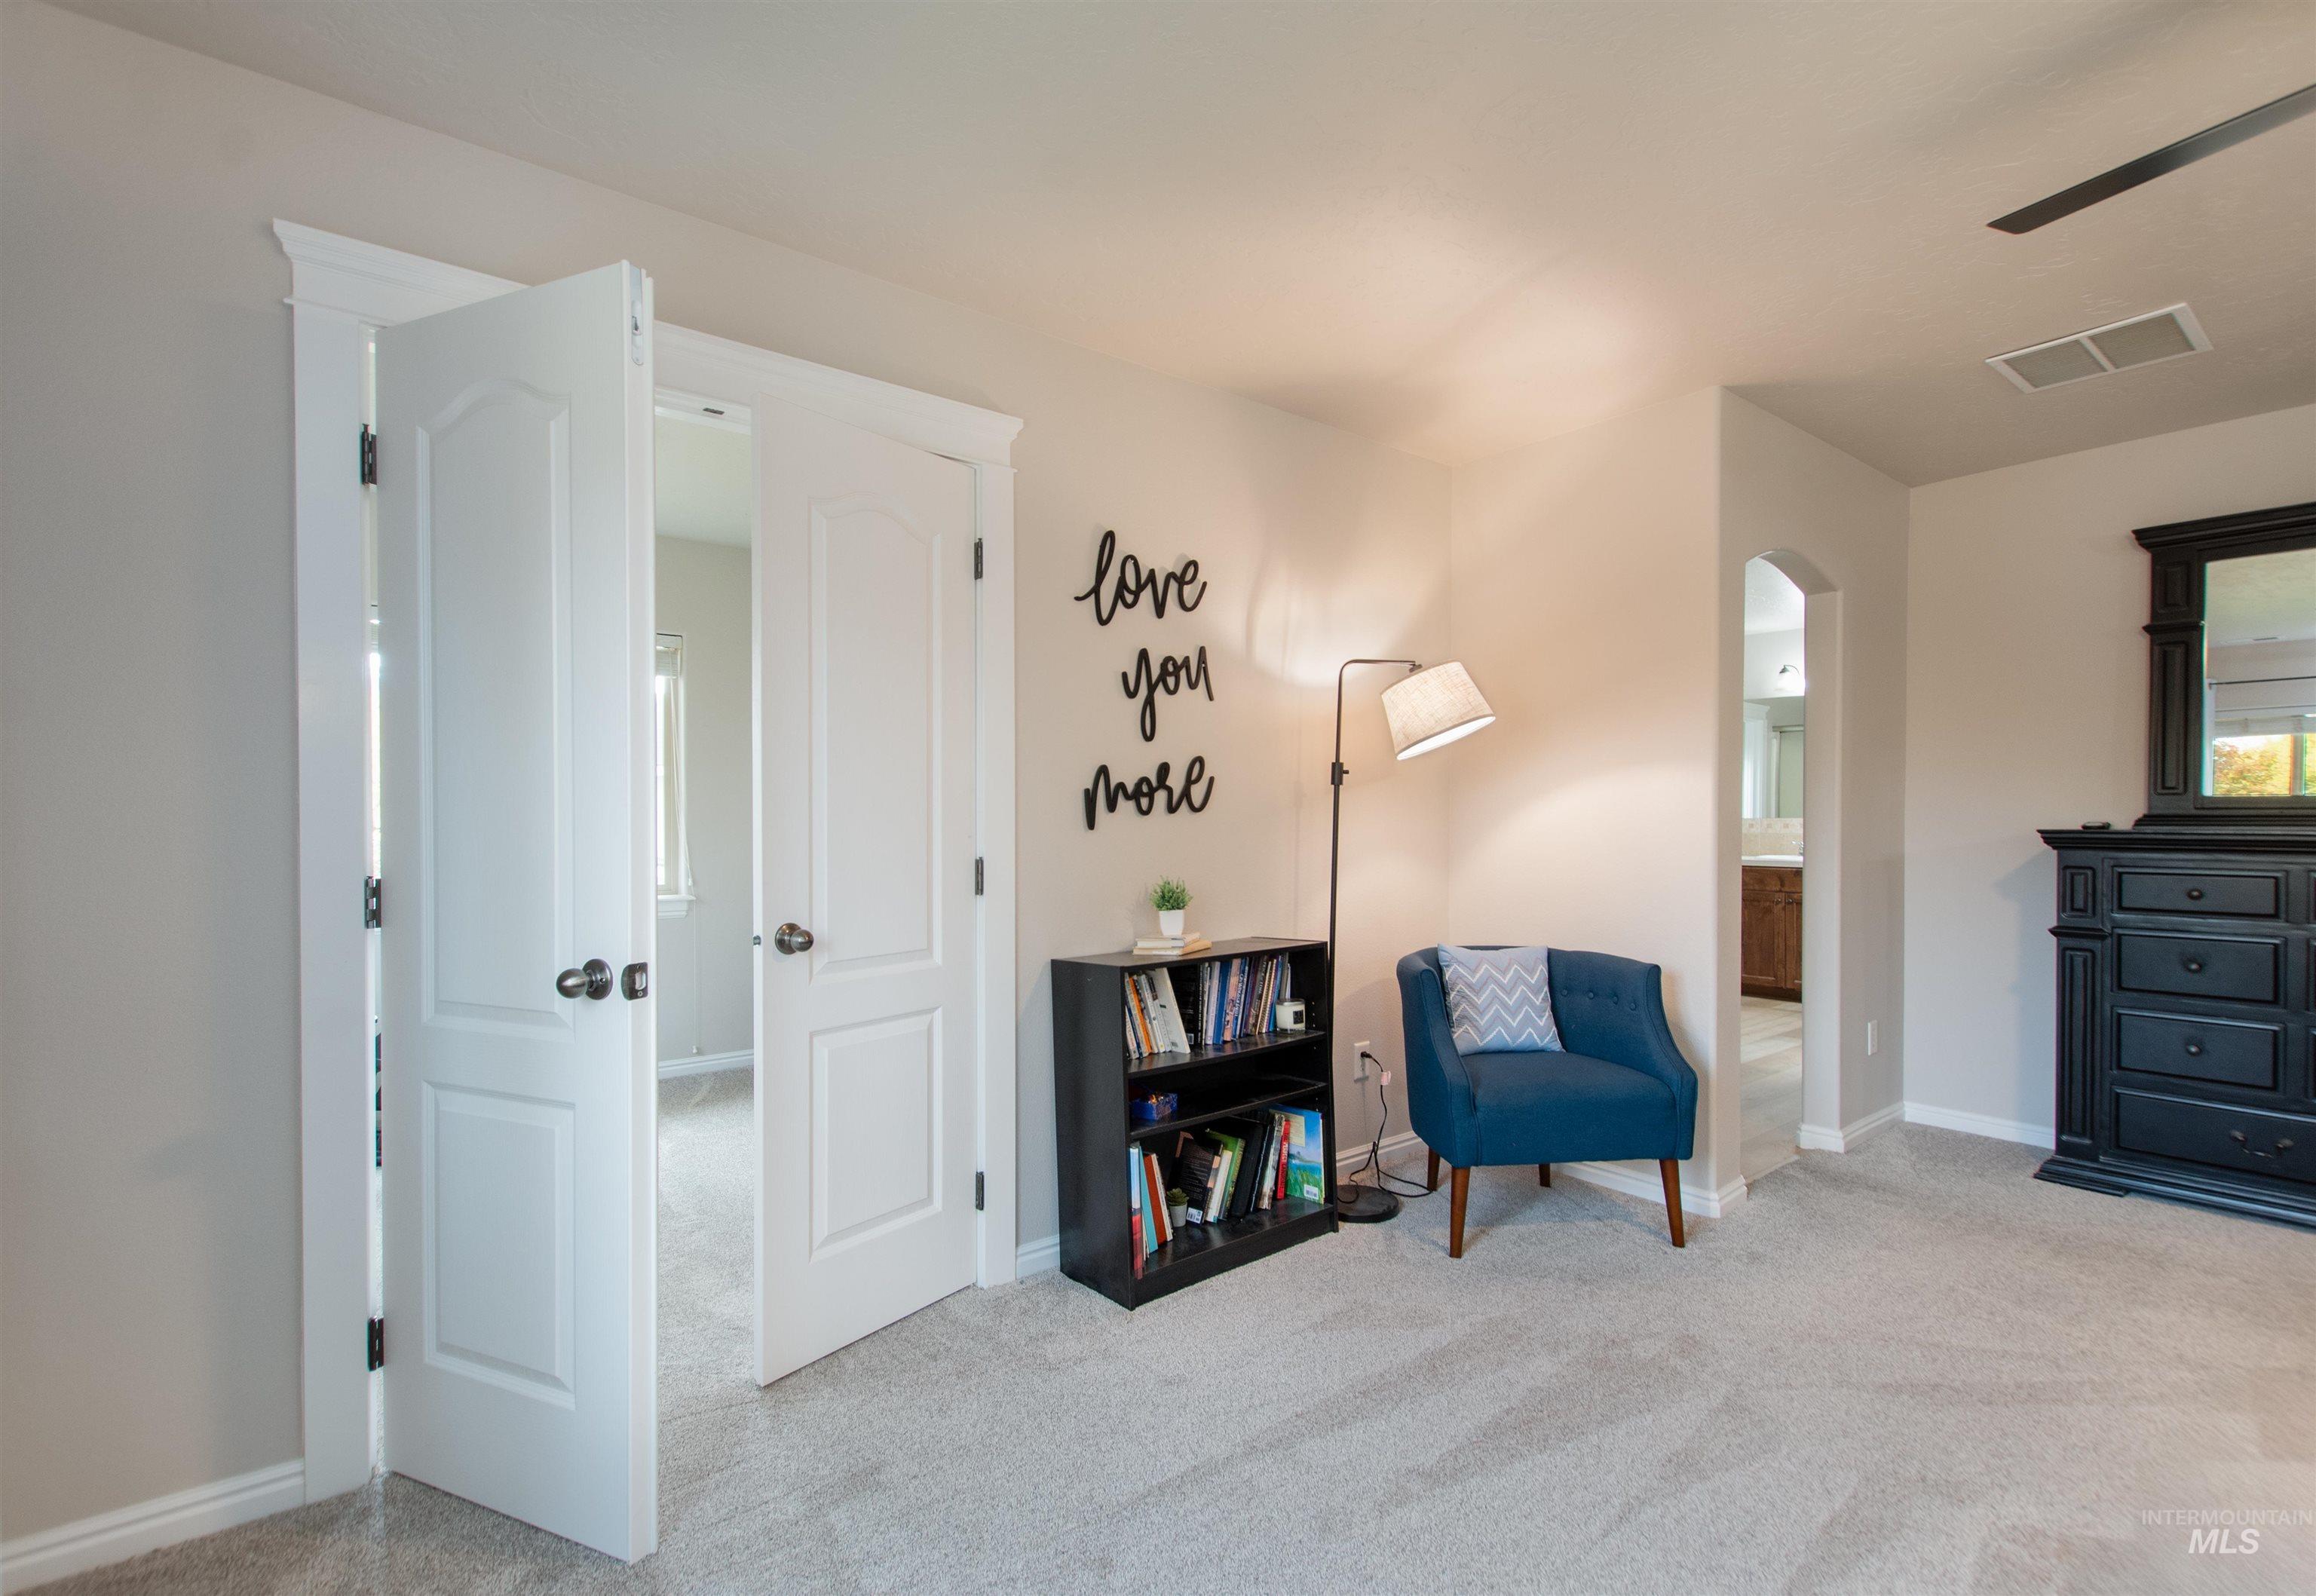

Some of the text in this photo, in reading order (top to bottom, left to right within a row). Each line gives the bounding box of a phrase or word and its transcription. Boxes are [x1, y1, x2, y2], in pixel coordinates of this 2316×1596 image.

[1074, 530, 1207, 626] love
[1122, 646, 1214, 742] you
[1084, 756, 1215, 830] more
